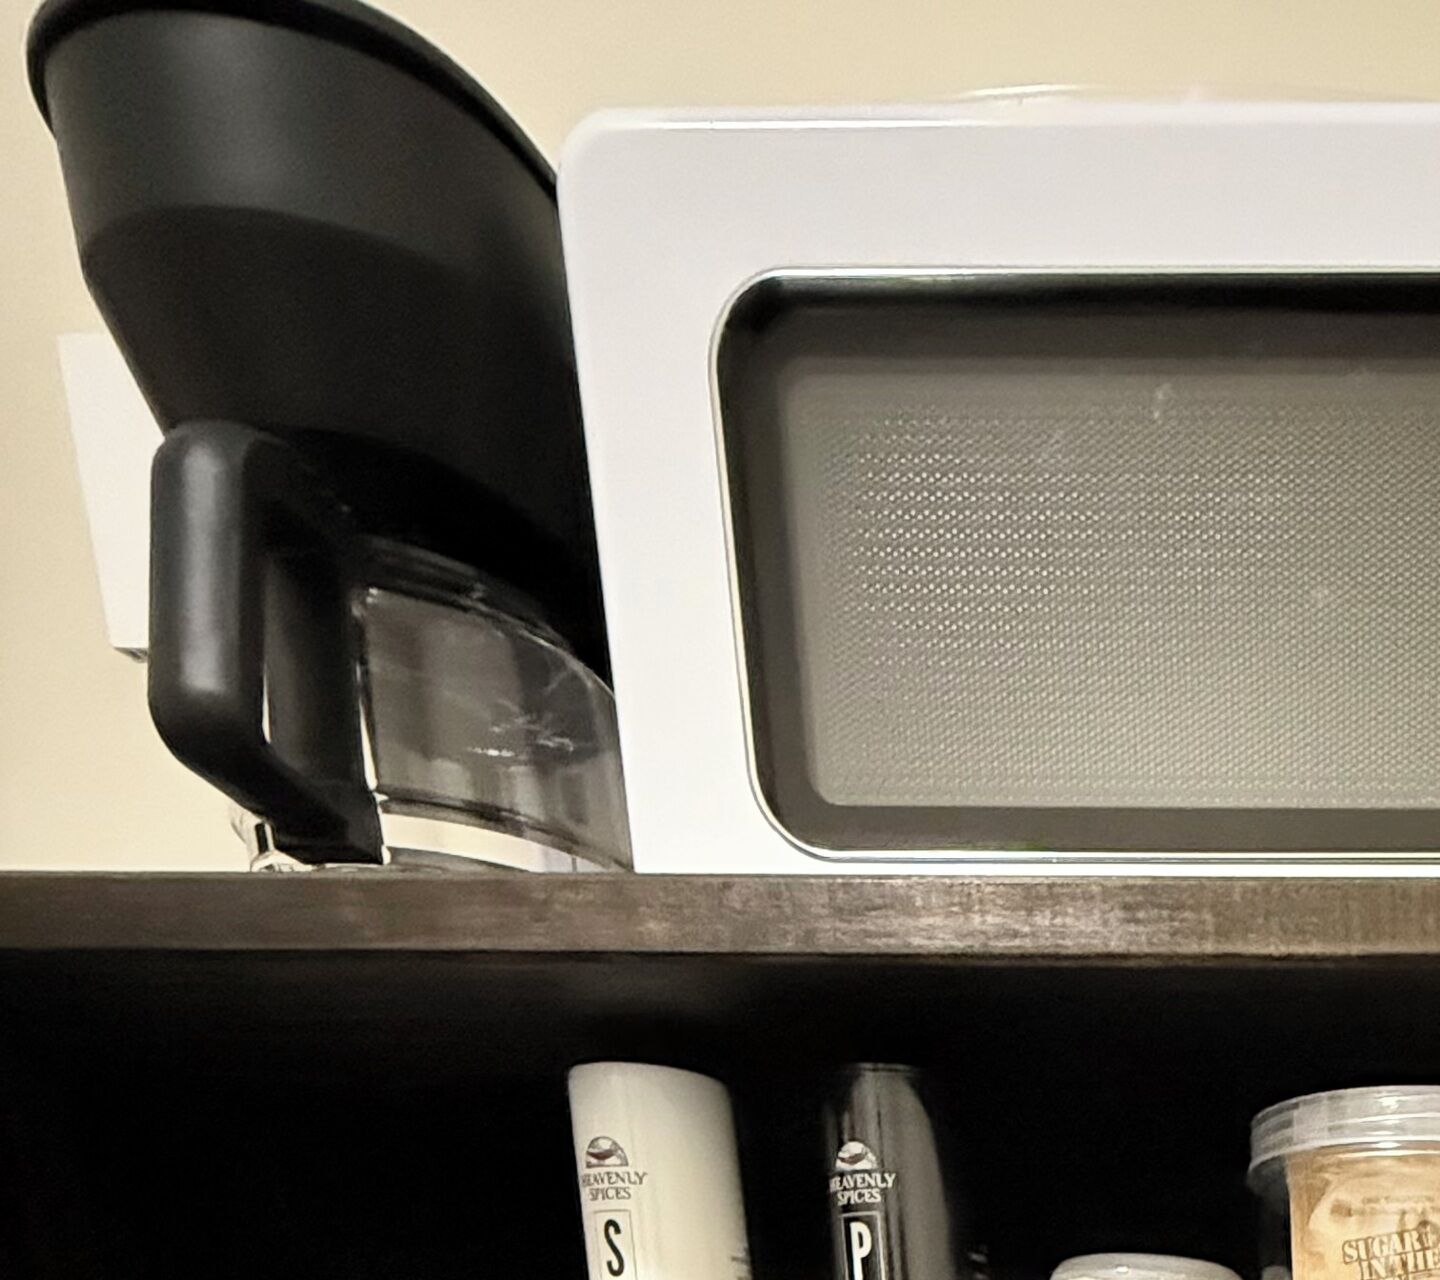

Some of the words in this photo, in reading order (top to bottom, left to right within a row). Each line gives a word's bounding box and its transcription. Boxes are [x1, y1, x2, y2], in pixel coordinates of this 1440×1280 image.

[581, 1171, 648, 1189] HEAVENLY
[830, 1172, 897, 1193] HEAVENLY
[589, 1187, 632, 1201] SPICES
[838, 1188, 882, 1206] SPICES
[603, 1219, 625, 1277] S
[1342, 1228, 1423, 1266] SUGAR
